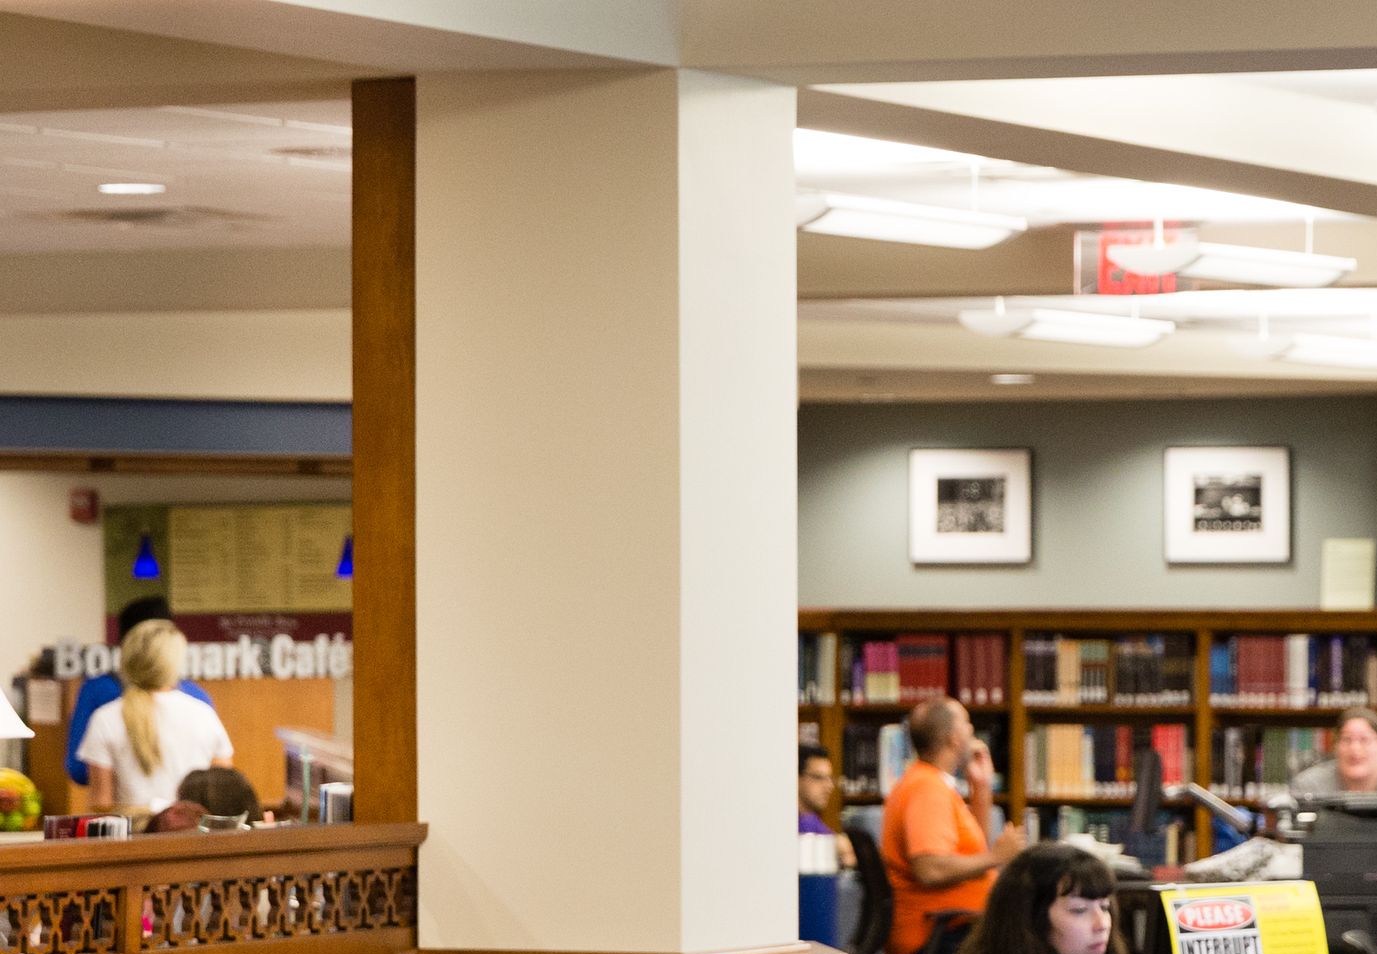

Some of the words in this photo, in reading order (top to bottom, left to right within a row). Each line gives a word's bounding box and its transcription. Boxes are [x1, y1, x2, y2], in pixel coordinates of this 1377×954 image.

[54, 635, 264, 679] Bomark
[270, 631, 351, 679] Café
[1183, 903, 1246, 927] PLEASE
